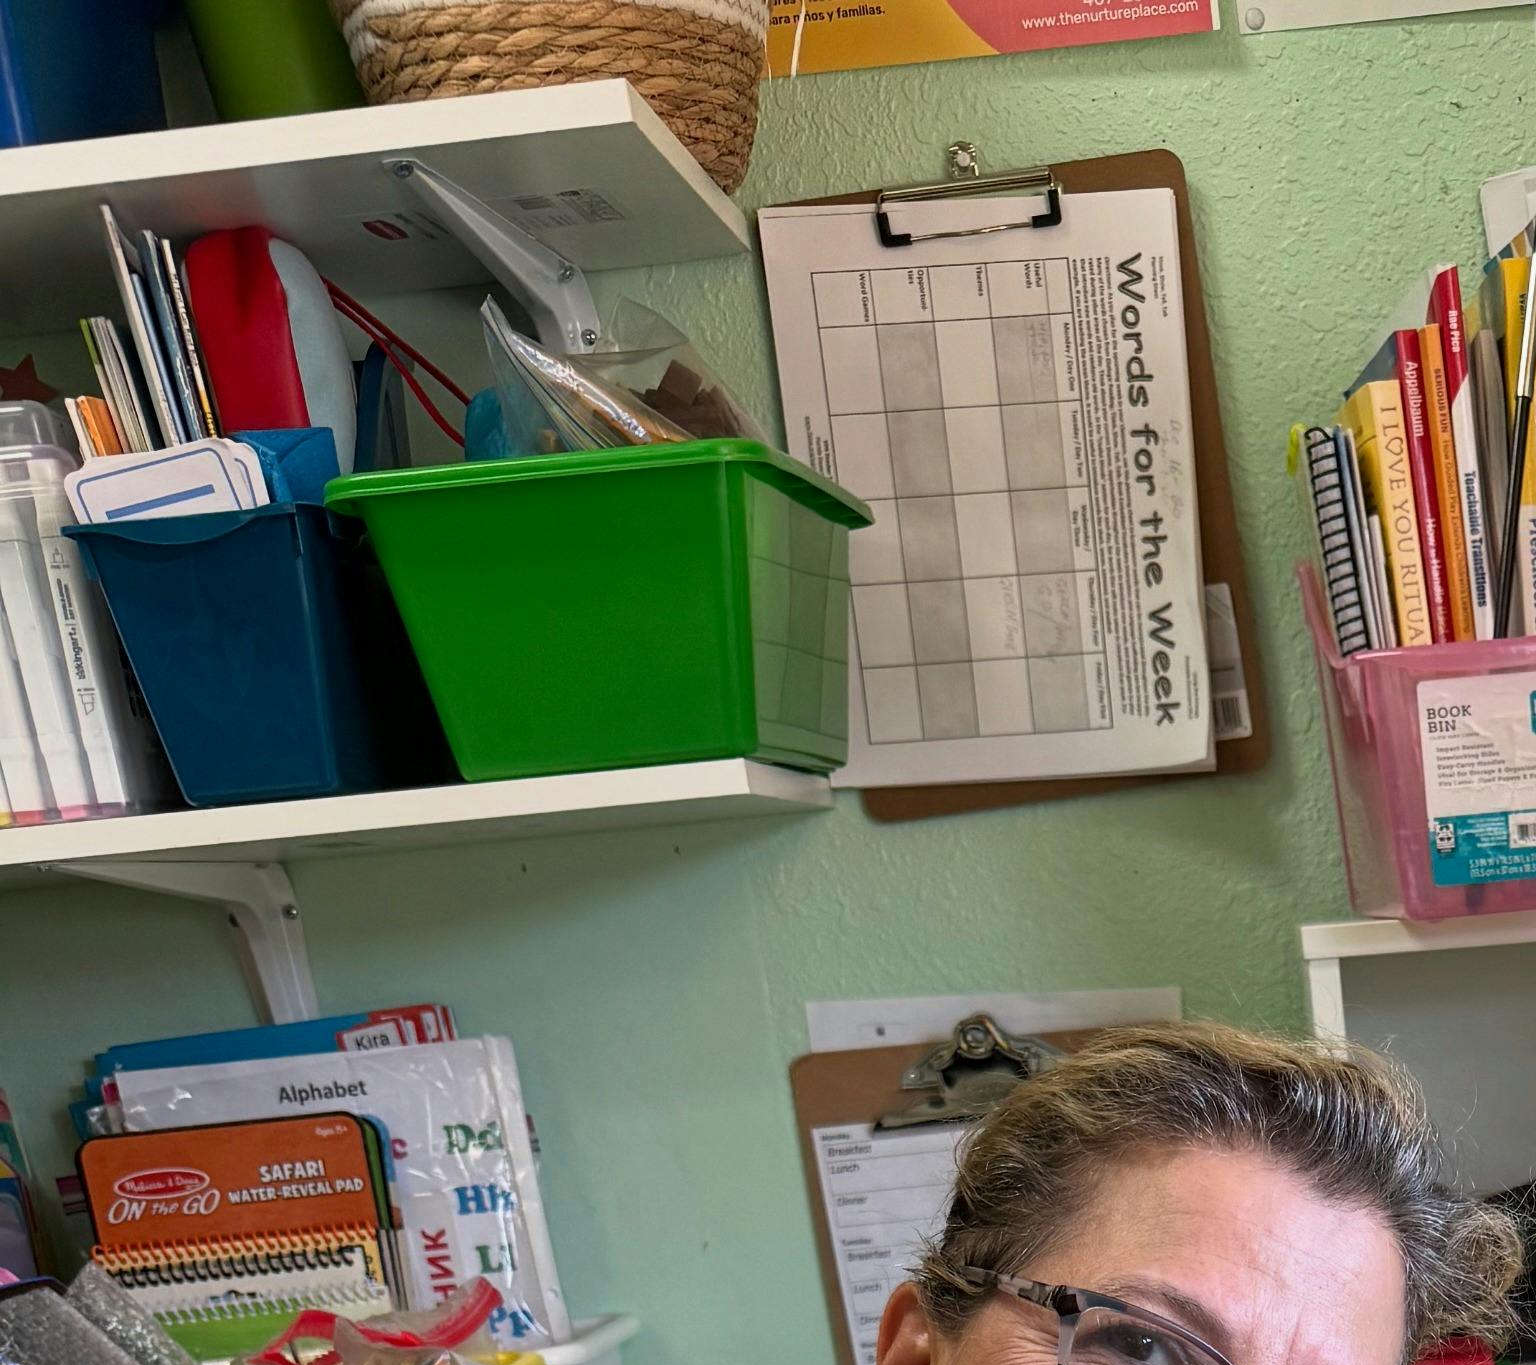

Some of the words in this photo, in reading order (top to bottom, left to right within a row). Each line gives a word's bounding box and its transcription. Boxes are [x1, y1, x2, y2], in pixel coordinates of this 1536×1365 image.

[836, 4, 886, 19] familias.
[1022, 1, 1199, 29] www.thenurtureplace.com
[858, 273, 869, 295] Word
[975, 266, 985, 297] Themes
[1023, 263, 1033, 289] Words
[861, 296, 871, 323] Games
[1062, 322, 1073, 353] Monday
[1116, 252, 1154, 407] Words
[1405, 361, 1425, 437] Appelbaum
[1433, 368, 1447, 411] SERIOUS
[1439, 411, 1449, 434] FUN
[1130, 423, 1160, 496] for
[1465, 470, 1481, 536] Teachable
[1393, 500, 1416, 553] YOU
[1425, 518, 1438, 547] How
[1140, 511, 1168, 588] the
[1472, 537, 1488, 608] Transitions
[1399, 563, 1425, 643] RITUA
[1148, 602, 1181, 726] Week
[1426, 704, 1472, 720] BOOK
[1427, 719, 1457, 733] BIN
[355, 1031, 391, 1051] Kira
[277, 1080, 368, 1105] Alphabet
[828, 1144, 872, 1157] Breakfast
[258, 1159, 326, 1183] SAFARI
[830, 1163, 860, 1175] Lunch
[228, 1181, 333, 1205] WATER-REVEAL
[334, 1177, 364, 1193] PAD
[108, 1198, 147, 1226] ON
[151, 1202, 179, 1216] the
[182, 1188, 221, 1215] GO
[852, 1283, 882, 1295] Lunch
